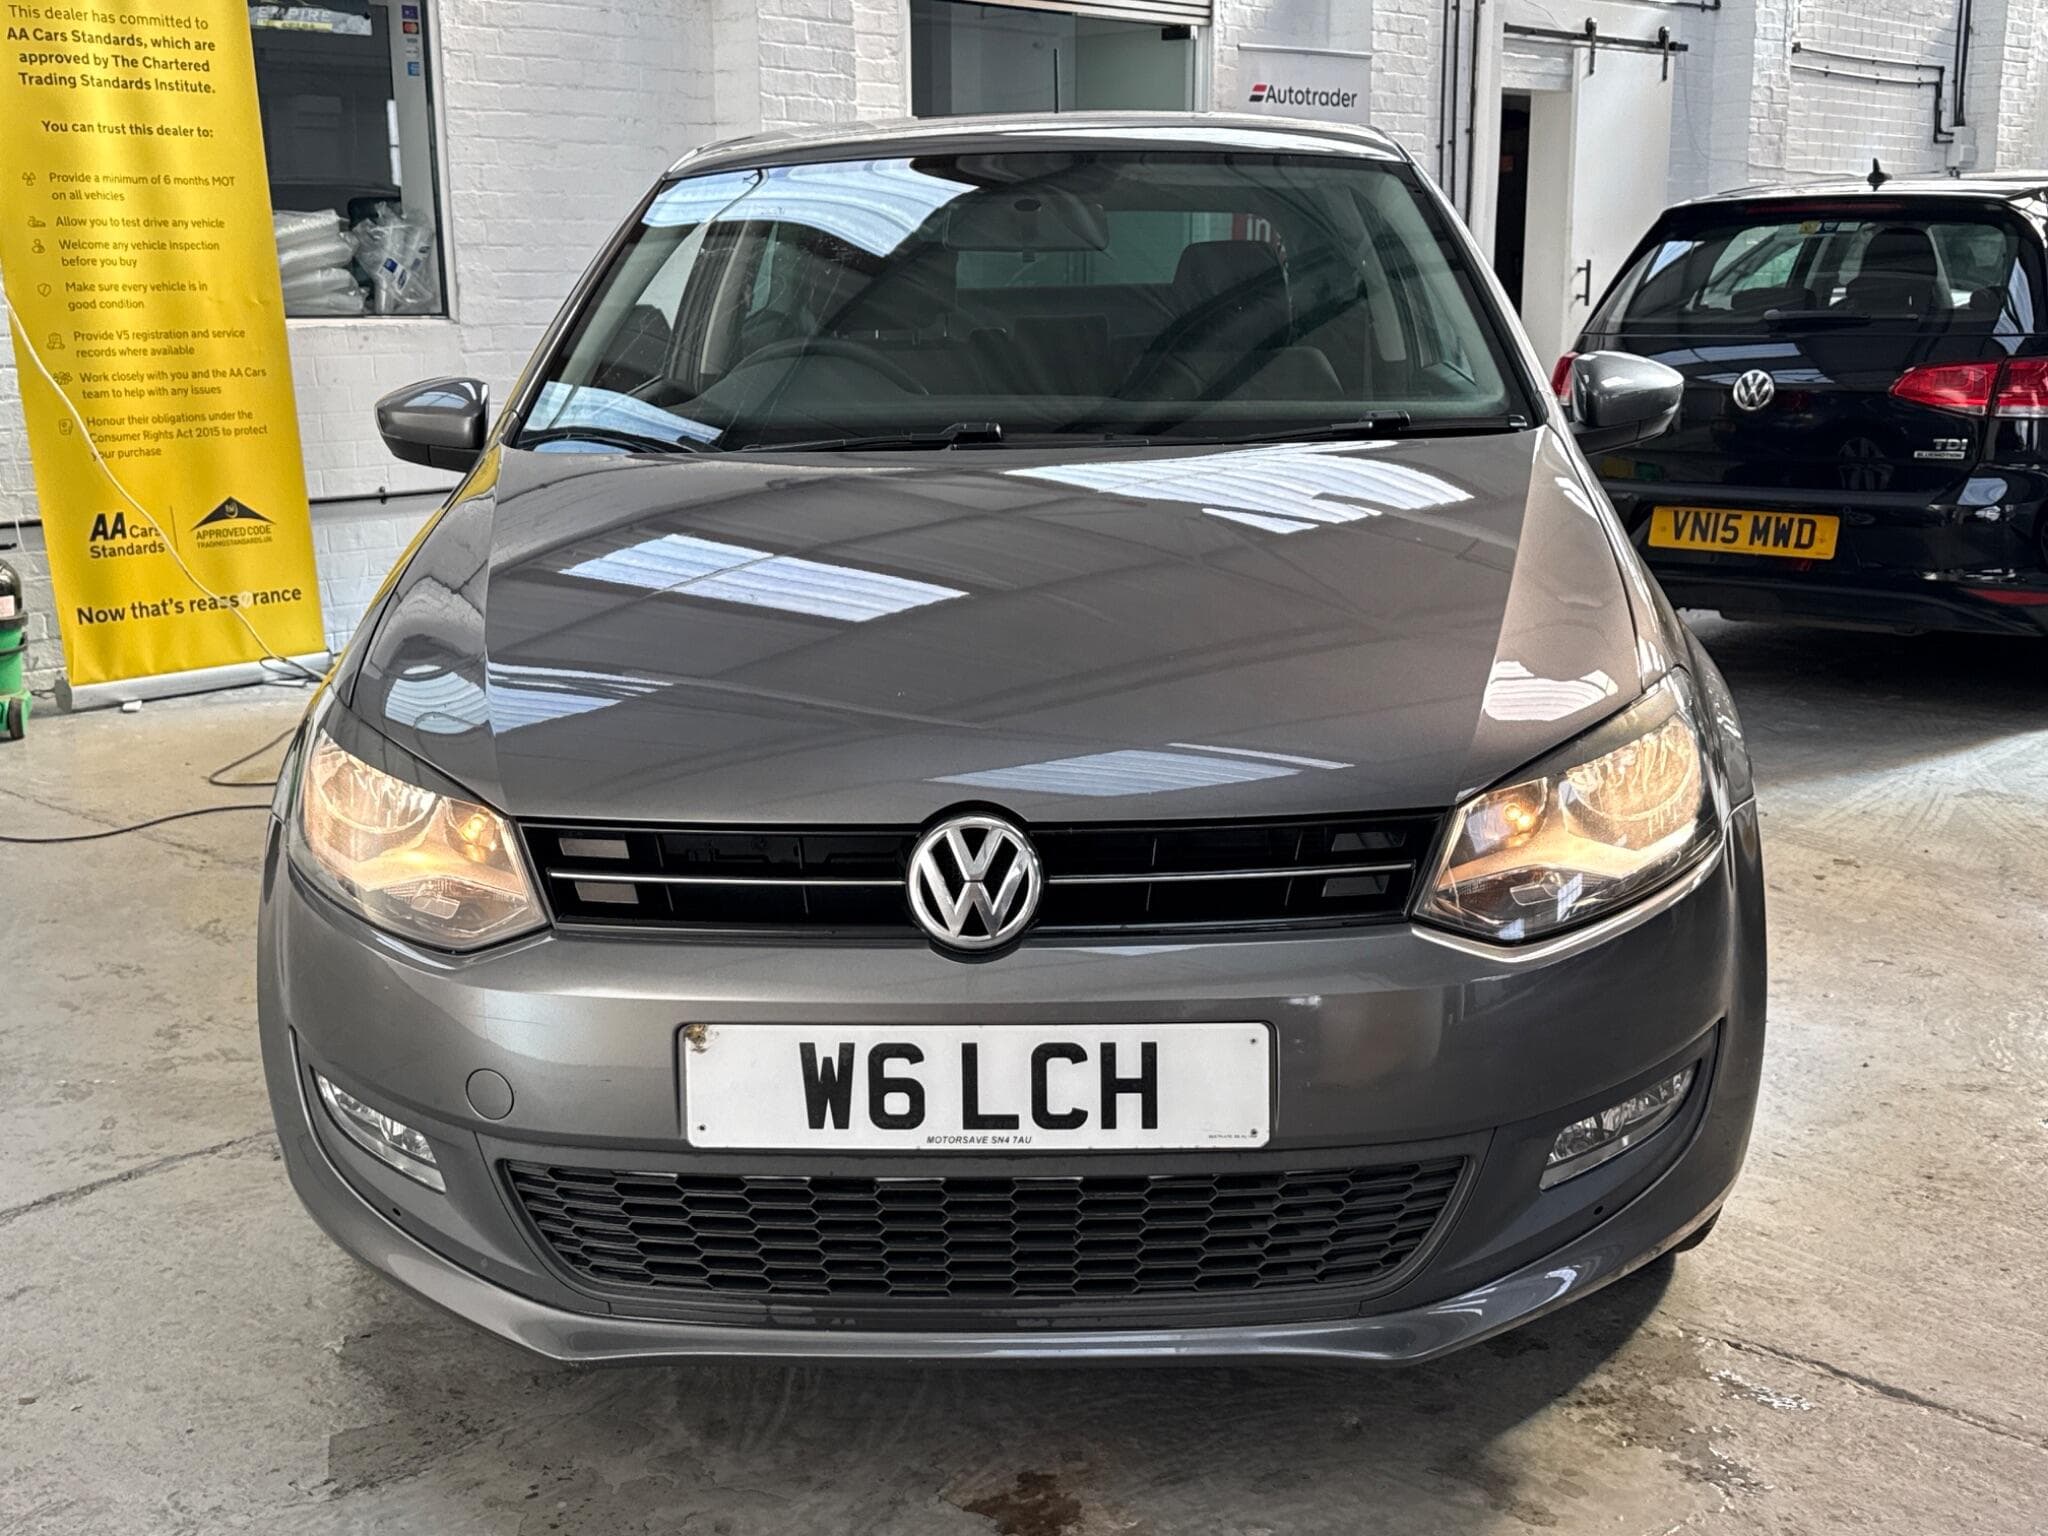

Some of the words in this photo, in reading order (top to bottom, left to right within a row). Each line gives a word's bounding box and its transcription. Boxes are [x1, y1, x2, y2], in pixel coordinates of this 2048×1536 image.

[8, 4, 40, 19] This
[45, 6, 88, 21] dealer
[92, 9, 116, 24] has
[119, 13, 192, 29] committed
[195, 16, 209, 30] to
[7, 26, 30, 41] AA
[32, 27, 68, 42] Cars
[71, 29, 148, 49] Standards,
[150, 35, 191, 51] which
[194, 41, 216, 51] are
[19, 52, 90, 66] approved
[93, 53, 109, 69] by
[111, 54, 139, 68] The
[142, 56, 210, 73] Chartered
[18, 72, 77, 89] Trading
[80, 74, 152, 91] Standards
[154, 78, 216, 94] Institute.
[1265, 85, 1358, 108] Autotrader
[41, 121, 69, 133] You
[71, 123, 95, 133] can
[97, 122, 127, 135] trust
[129, 123, 154, 136] this
[156, 124, 194, 137] dealer
[196, 126, 214, 139] to:
[49, 172, 92, 183] Provide
[94, 174, 101, 183] a
[102, 173, 149, 185] minimum
[150, 174, 162, 185] of
[163, 174, 172, 185] 6
[173, 175, 210, 187] months
[211, 176, 235, 187] MOT
[51, 191, 67, 201] on
[69, 190, 82, 200] all
[84, 190, 125, 202] vehicles
[56, 216, 87, 228] Allow
[89, 218, 107, 229] you
[109, 217, 121, 228] to
[122, 217, 140, 228] test
[143, 217, 170, 228] drive
[171, 219, 189, 230] any
[190, 218, 226, 229] vehicle
[59, 240, 110, 251] Welcome
[112, 243, 129, 252] any
[131, 240, 168, 251] vehicle
[61, 256, 98, 267] before
[100, 258, 118, 269] you
[119, 257, 137, 269] buy
[65, 281, 96, 292] Make
[98, 283, 120, 292] sure
[121, 283, 147, 294] every
[149, 281, 187, 292] vehicle
[188, 280, 198, 292] is
[199, 280, 209, 292] in
[68, 299, 97, 312] good
[99, 299, 145, 310] condition
[73, 330, 114, 342] Provide
[115, 329, 130, 341] V5
[132, 328, 189, 341] registration
[191, 328, 210, 339] and
[211, 327, 246, 339] service
[76, 347, 117, 359] records
[118, 346, 149, 357] where
[150, 344, 196, 357] available
[79, 371, 109, 383] Work
[111, 370, 145, 383] closely
[146, 369, 169, 381] with
[170, 371, 190, 383] you
[191, 368, 210, 380] and
[211, 368, 228, 379] the
[229, 367, 244, 379] AA
[244, 366, 268, 378] Cars
[82, 388, 111, 400] team
[112, 388, 123, 399] to
[124, 386, 146, 400] help
[147, 386, 169, 398] with
[170, 387, 189, 399] any
[190, 385, 222, 396] issues
[86, 415, 126, 428] Honour
[127, 413, 150, 426] their
[151, 411, 207, 426] obligations
[208, 410, 236, 422] under
[237, 409, 254, 421] the
[89, 432, 141, 445] Consumer
[142, 429, 174, 443] Rights
[175, 428, 194, 440] Act
[195, 426, 221, 440] 2015
[222, 426, 233, 438] to
[234, 424, 269, 438] protect
[1933, 438, 1969, 450] TDI
[117, 447, 162, 461] purchase
[89, 512, 128, 543] AA
[129, 524, 161, 540] Cars
[196, 526, 247, 541] APPROVED
[247, 524, 272, 536] CODE
[1673, 510, 1743, 545] VN15
[1748, 514, 1817, 550] MWD
[89, 540, 166, 560] Standards
[76, 605, 126, 625] Now
[189, 587, 302, 613] reassrance
[799, 1041, 926, 1130] W6
[961, 1041, 1159, 1130] LCH
[926, 1135, 989, 1145] MOTORSAVE
[991, 1135, 1010, 1145] SN4
[1012, 1135, 1032, 1145] 7AU
